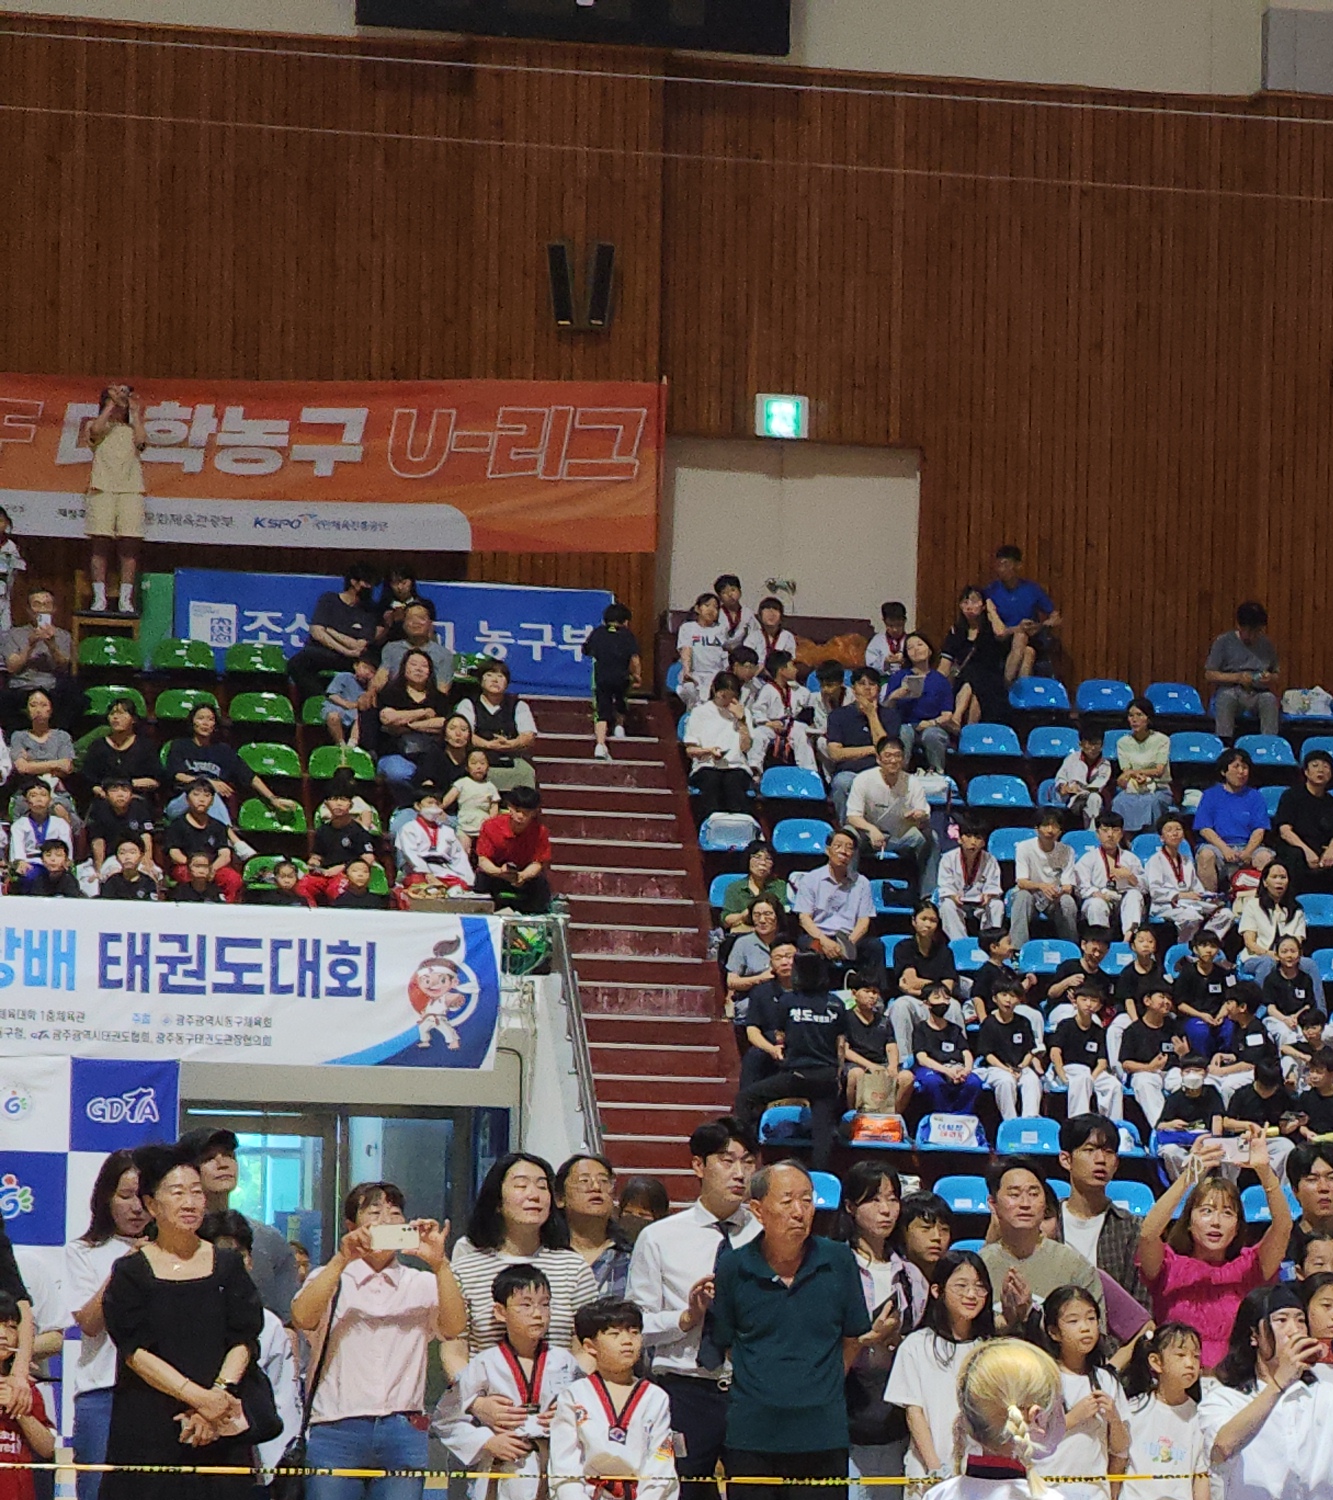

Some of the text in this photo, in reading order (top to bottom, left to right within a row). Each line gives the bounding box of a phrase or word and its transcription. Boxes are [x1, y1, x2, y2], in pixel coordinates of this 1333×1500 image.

[388, 406, 647, 479] U-리그
[253, 516, 302, 529] KSPO
[475, 619, 592, 661] 농구부
[692, 635, 722, 647] FILA
[98, 931, 376, 1002] 태권도대회
